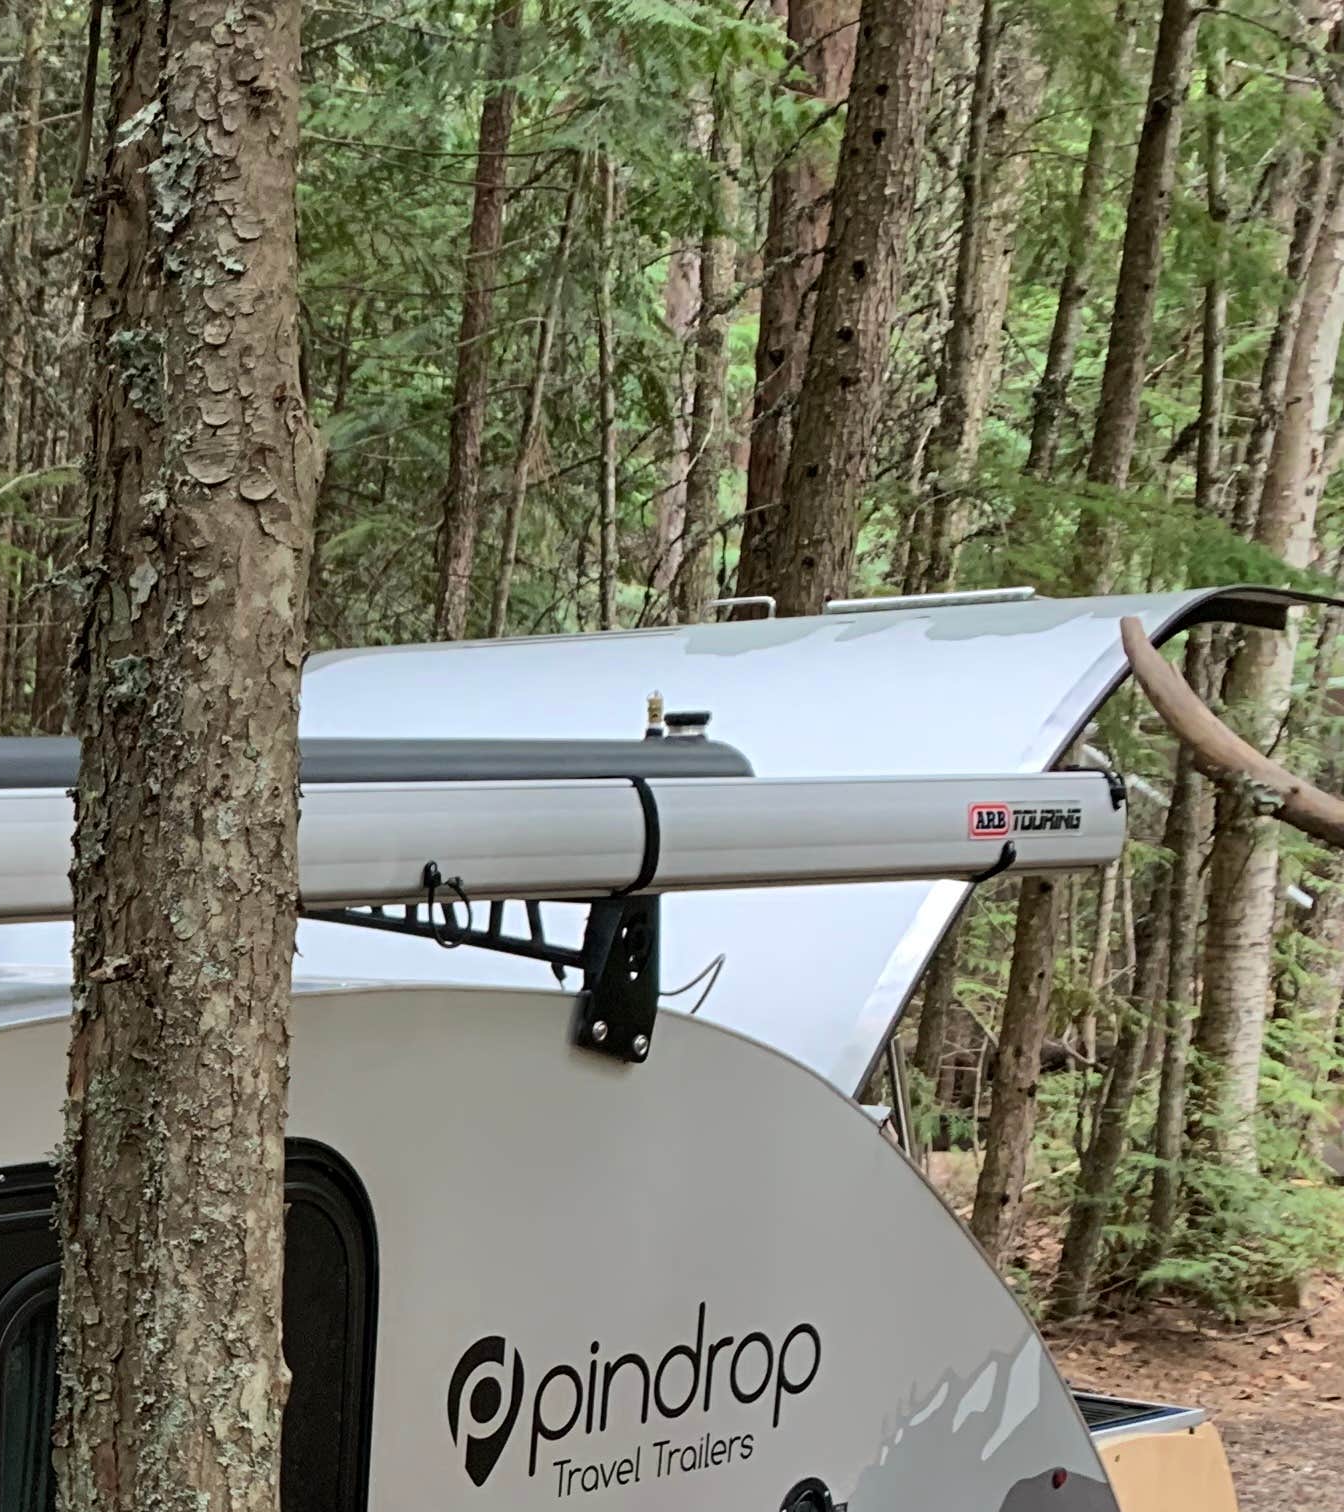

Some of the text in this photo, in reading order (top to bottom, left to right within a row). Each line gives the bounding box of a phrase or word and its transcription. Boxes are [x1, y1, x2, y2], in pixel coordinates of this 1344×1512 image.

[976, 808, 1082, 831] ARB TOURING
[528, 1301, 822, 1478] pindrop
[553, 1432, 755, 1498] Travel Trailers
